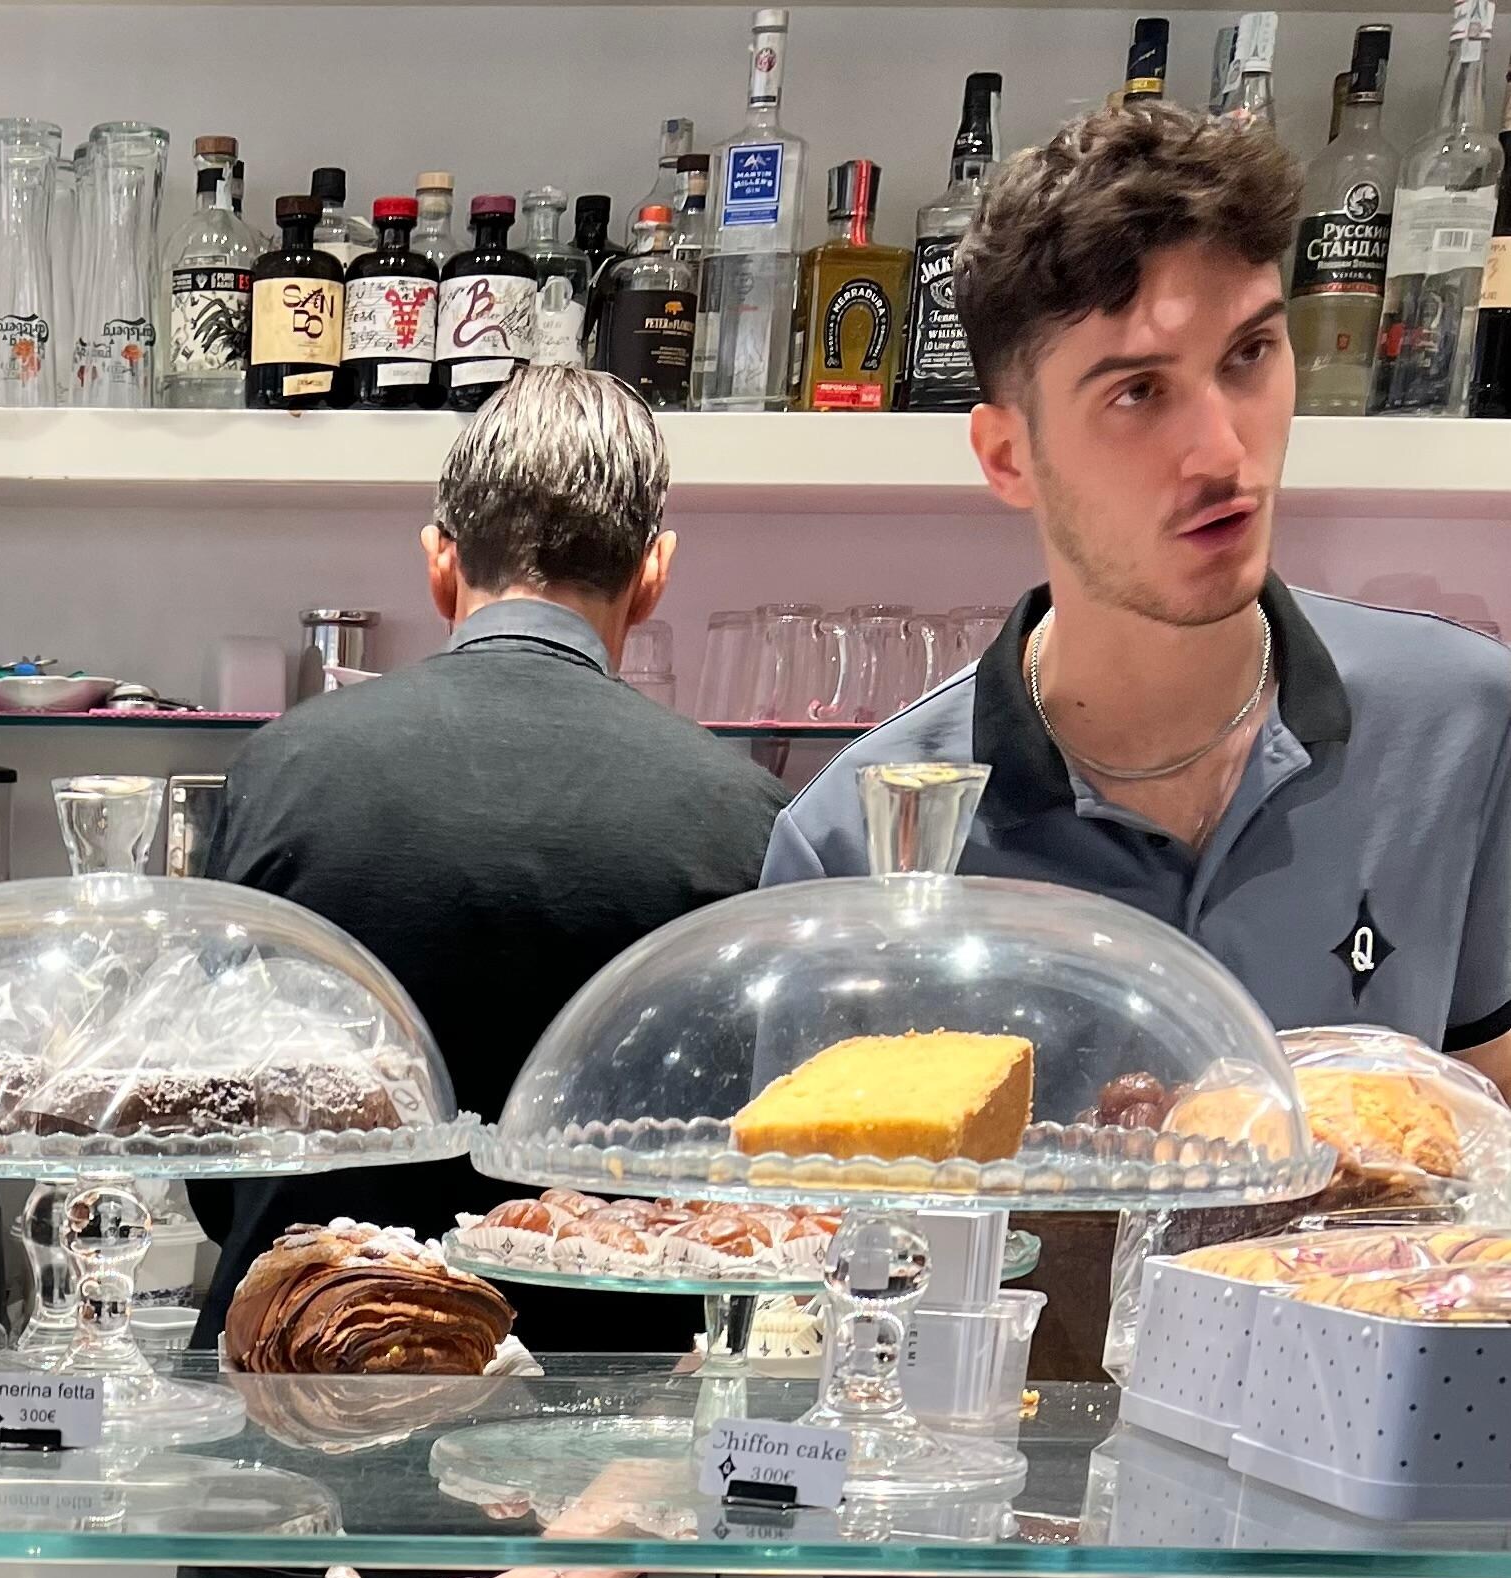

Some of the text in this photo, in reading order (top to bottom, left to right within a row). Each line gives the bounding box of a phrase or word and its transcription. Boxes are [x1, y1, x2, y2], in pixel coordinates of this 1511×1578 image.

[832, 287, 886, 317] HERRADURA
[1350, 926, 1375, 972] Q
[57, 1382, 96, 1401] fetta
[796, 1439, 848, 1463] cake
